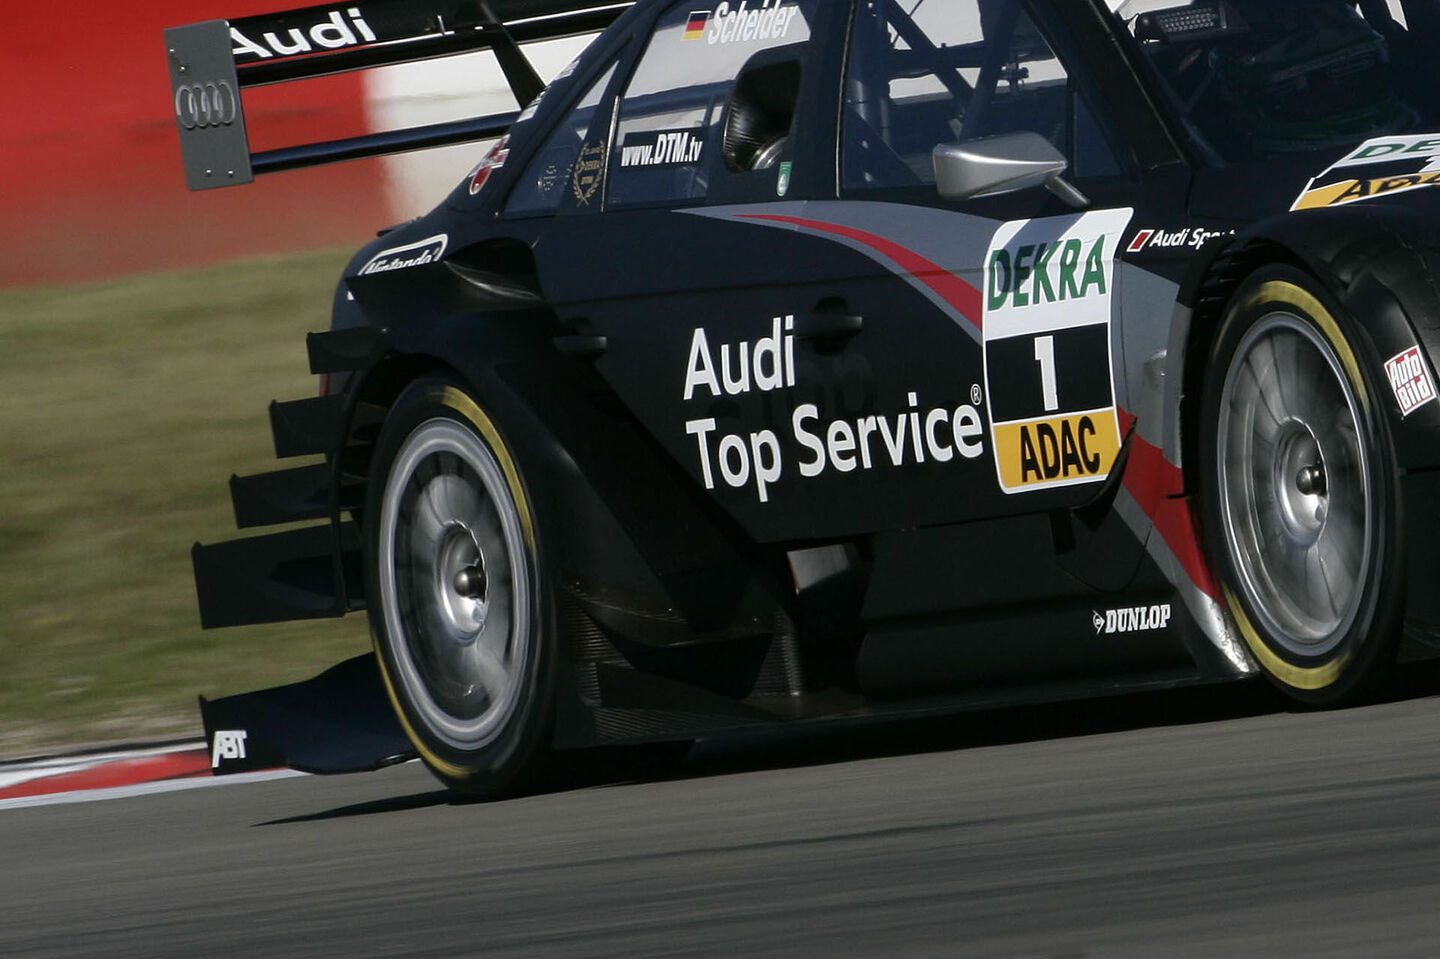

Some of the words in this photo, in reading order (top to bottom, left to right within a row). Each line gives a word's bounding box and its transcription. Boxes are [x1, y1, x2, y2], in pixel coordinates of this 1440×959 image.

[229, 7, 377, 58] Audi
[619, 132, 703, 167] www.DTM.tv
[1148, 228, 1191, 248] Audi
[987, 234, 1108, 312] DEKRA
[683, 314, 797, 401] Audi
[1034, 334, 1059, 412] 1
[1388, 352, 1423, 390] Auto
[1396, 374, 1432, 412] Bild
[685, 417, 783, 503] Top
[1020, 415, 1101, 483] ADAC
[1104, 603, 1171, 634] DUNLOP
[211, 730, 248, 768] ABT
